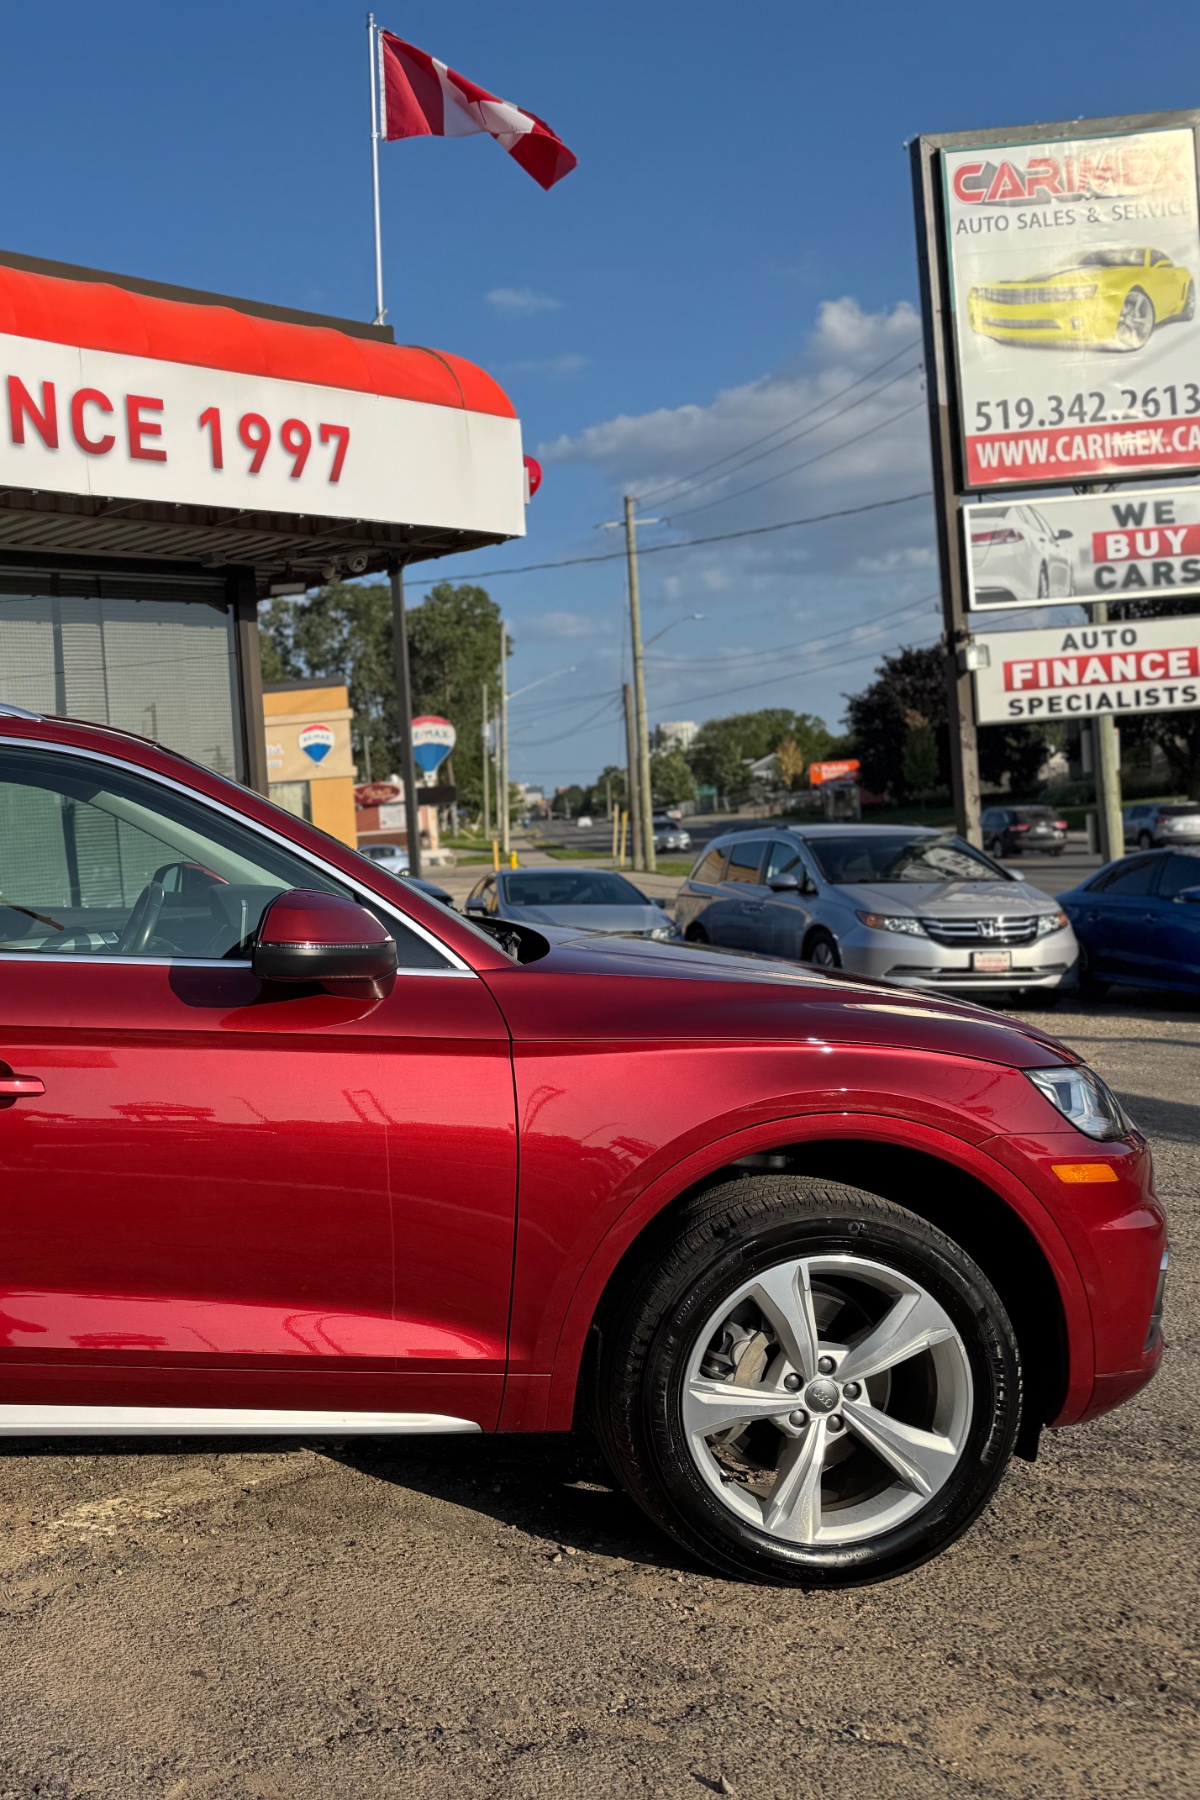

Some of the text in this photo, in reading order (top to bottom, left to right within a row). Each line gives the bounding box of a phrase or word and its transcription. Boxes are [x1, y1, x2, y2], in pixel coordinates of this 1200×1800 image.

[952, 146, 1188, 204] CARIMEX
[956, 199, 1190, 235] AUTO SALES & SERVICE
[975, 383, 1200, 432] 519.342.2613
[199, 406, 351, 483] 1997
[1111, 501, 1176, 528] WE
[1105, 529, 1188, 560] BUY
[1094, 559, 1200, 590] CARS
[1061, 628, 1138, 651] AUTO
[1011, 650, 1192, 690] FINANCE
[1008, 685, 1198, 716] SPECIALISTS
